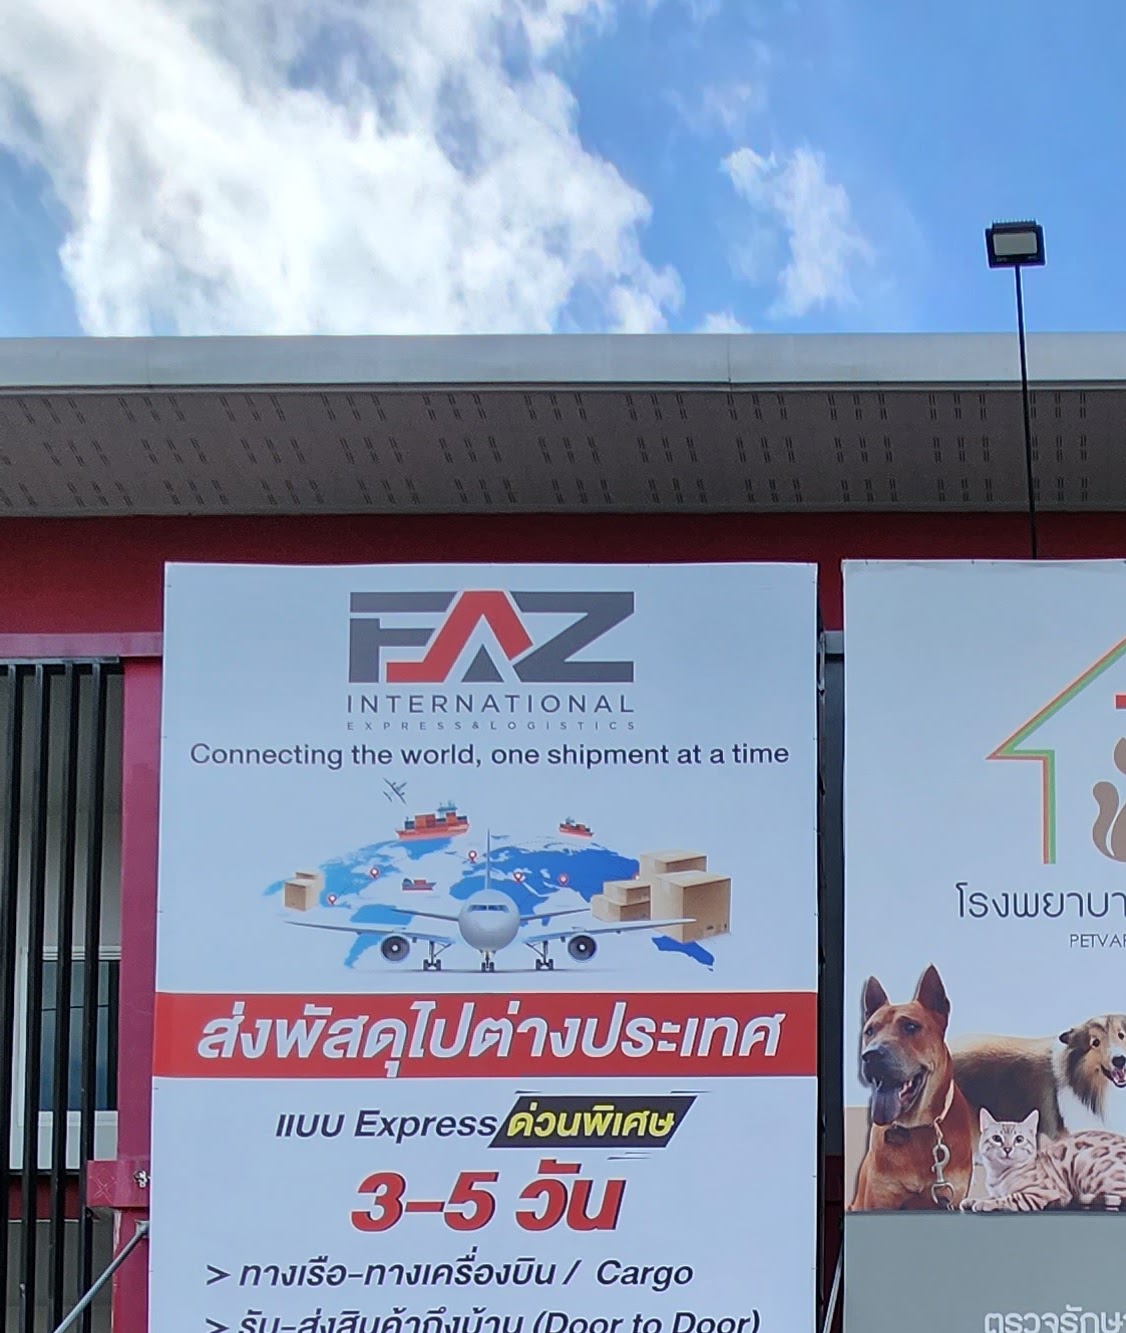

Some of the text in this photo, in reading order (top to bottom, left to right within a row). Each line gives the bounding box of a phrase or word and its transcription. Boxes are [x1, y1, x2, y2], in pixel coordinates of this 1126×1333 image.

[349, 591, 634, 683] FAZ
[348, 694, 634, 713] INTERNATIONAL
[191, 743, 788, 770] Connecting the world, one shipment at a time
[197, 1001, 787, 1078] ส่งพัสดุไปต่างประเทศ
[276, 1103, 676, 1144] แบบ Express ด่วนพิเศษ
[516, 1158, 627, 1231] วัน
[240, 1246, 556, 1286] ทางเรือ-ทางเครื่องบิน
[597, 1260, 693, 1291] Cargo
